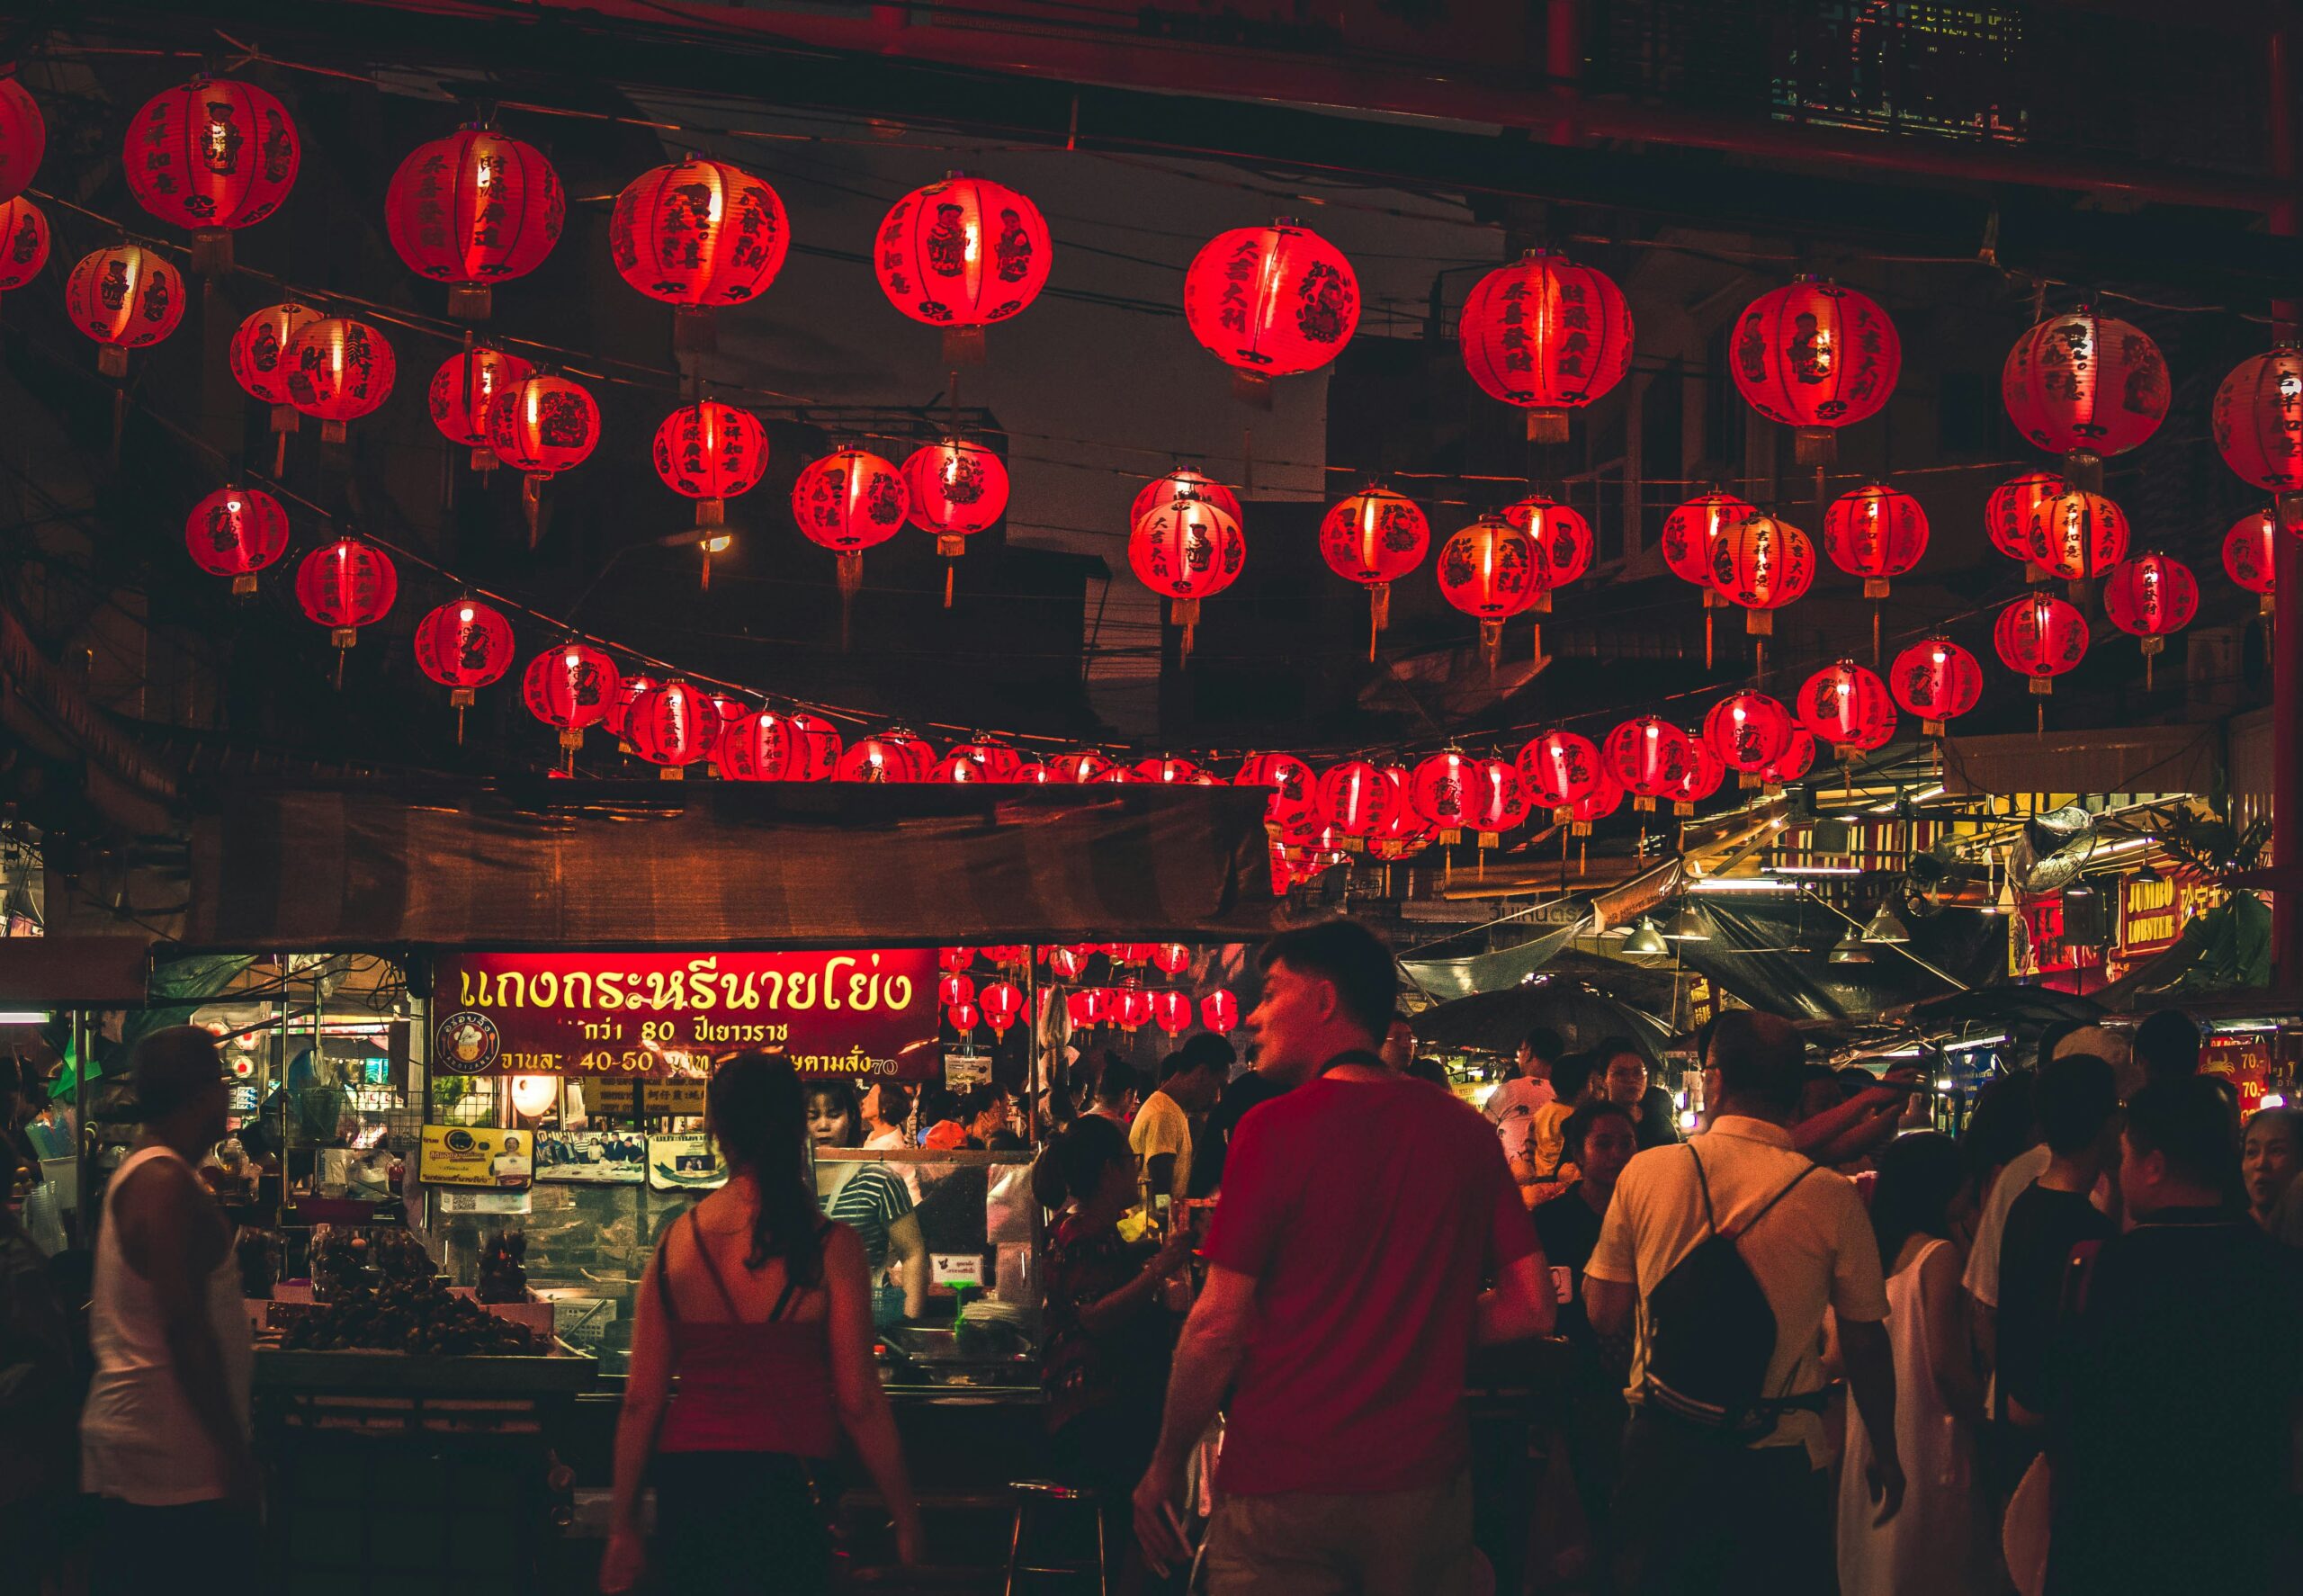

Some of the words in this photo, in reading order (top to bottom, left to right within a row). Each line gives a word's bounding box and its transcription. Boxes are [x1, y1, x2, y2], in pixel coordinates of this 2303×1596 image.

[1220, 240, 1259, 334] 大吉大利
[722, 412, 744, 473] 吉祥如意
[1151, 517, 1169, 578] 大吉大利
[1752, 529, 1772, 588] 吉祥如意
[2059, 502, 2081, 559] 吉祥如意
[2099, 503, 2115, 560] 大吉大利
[1781, 530, 1803, 591] 大吉大利
[2142, 563, 2158, 615] 恭喜發財
[764, 723, 783, 775] 吉祥如意
[2128, 875, 2174, 913] JUMBO
[2128, 915, 2175, 945] LOBSTER
[641, 1021, 675, 1041] 80
[693, 1015, 788, 1042] ปีเยาวราช
[501, 1053, 563, 1071] จานละ
[580, 1051, 654, 1071] 40-50
[871, 1059, 898, 1075] 70
